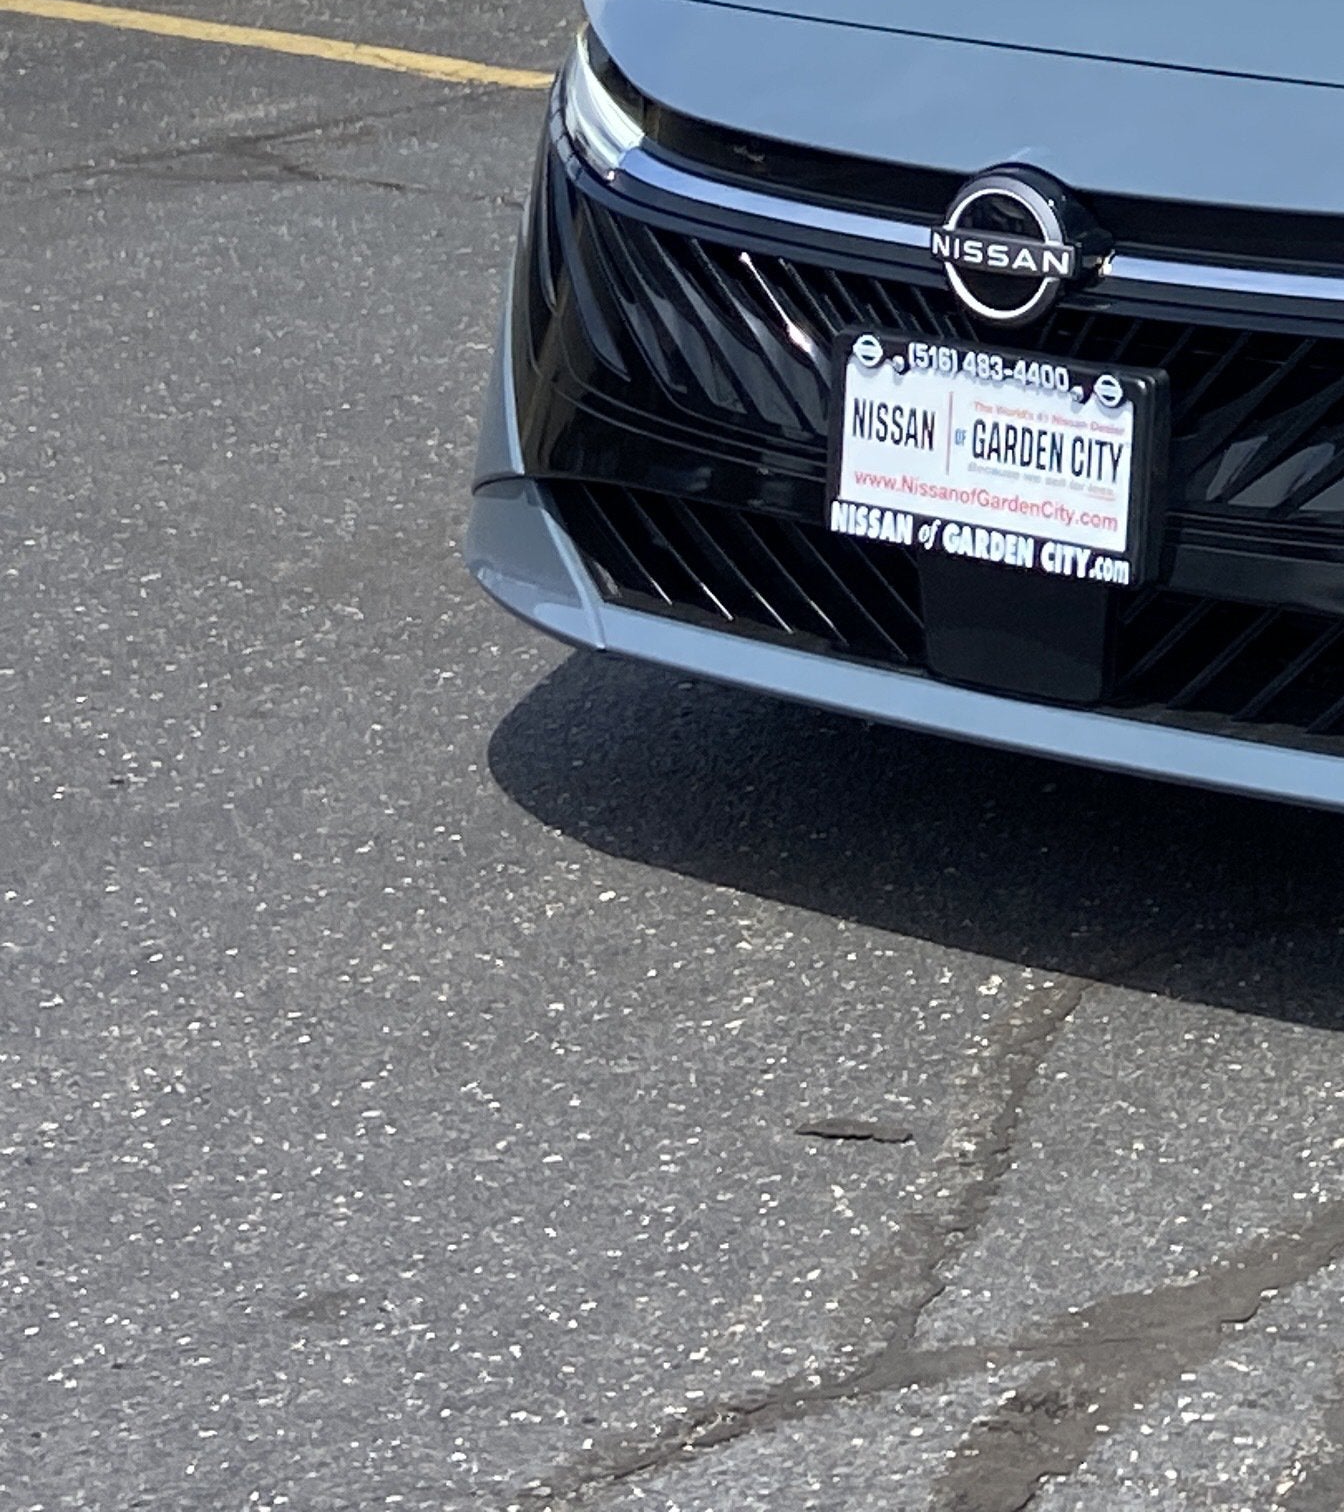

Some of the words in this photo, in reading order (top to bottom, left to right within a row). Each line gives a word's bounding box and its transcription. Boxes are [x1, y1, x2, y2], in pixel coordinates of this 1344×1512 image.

[932, 232, 1070, 275] NISSAN
[908, 343, 958, 374] (516)
[962, 351, 1069, 392] 483-4400
[852, 397, 936, 451] NISSAN
[972, 418, 1065, 474] GARDEN
[1071, 435, 1124, 483] CITY
[974, 400, 993, 414] The
[996, 405, 1034, 420] World's
[1051, 414, 1088, 428] Nissan
[1090, 421, 1125, 435] Dealer
[854, 470, 1119, 532] www.NissanofGardenCity.com
[830, 500, 913, 545] NISSAN
[918, 519, 942, 550] of
[942, 525, 1035, 568] GARDEN
[1041, 543, 1130, 585] CITY.com
